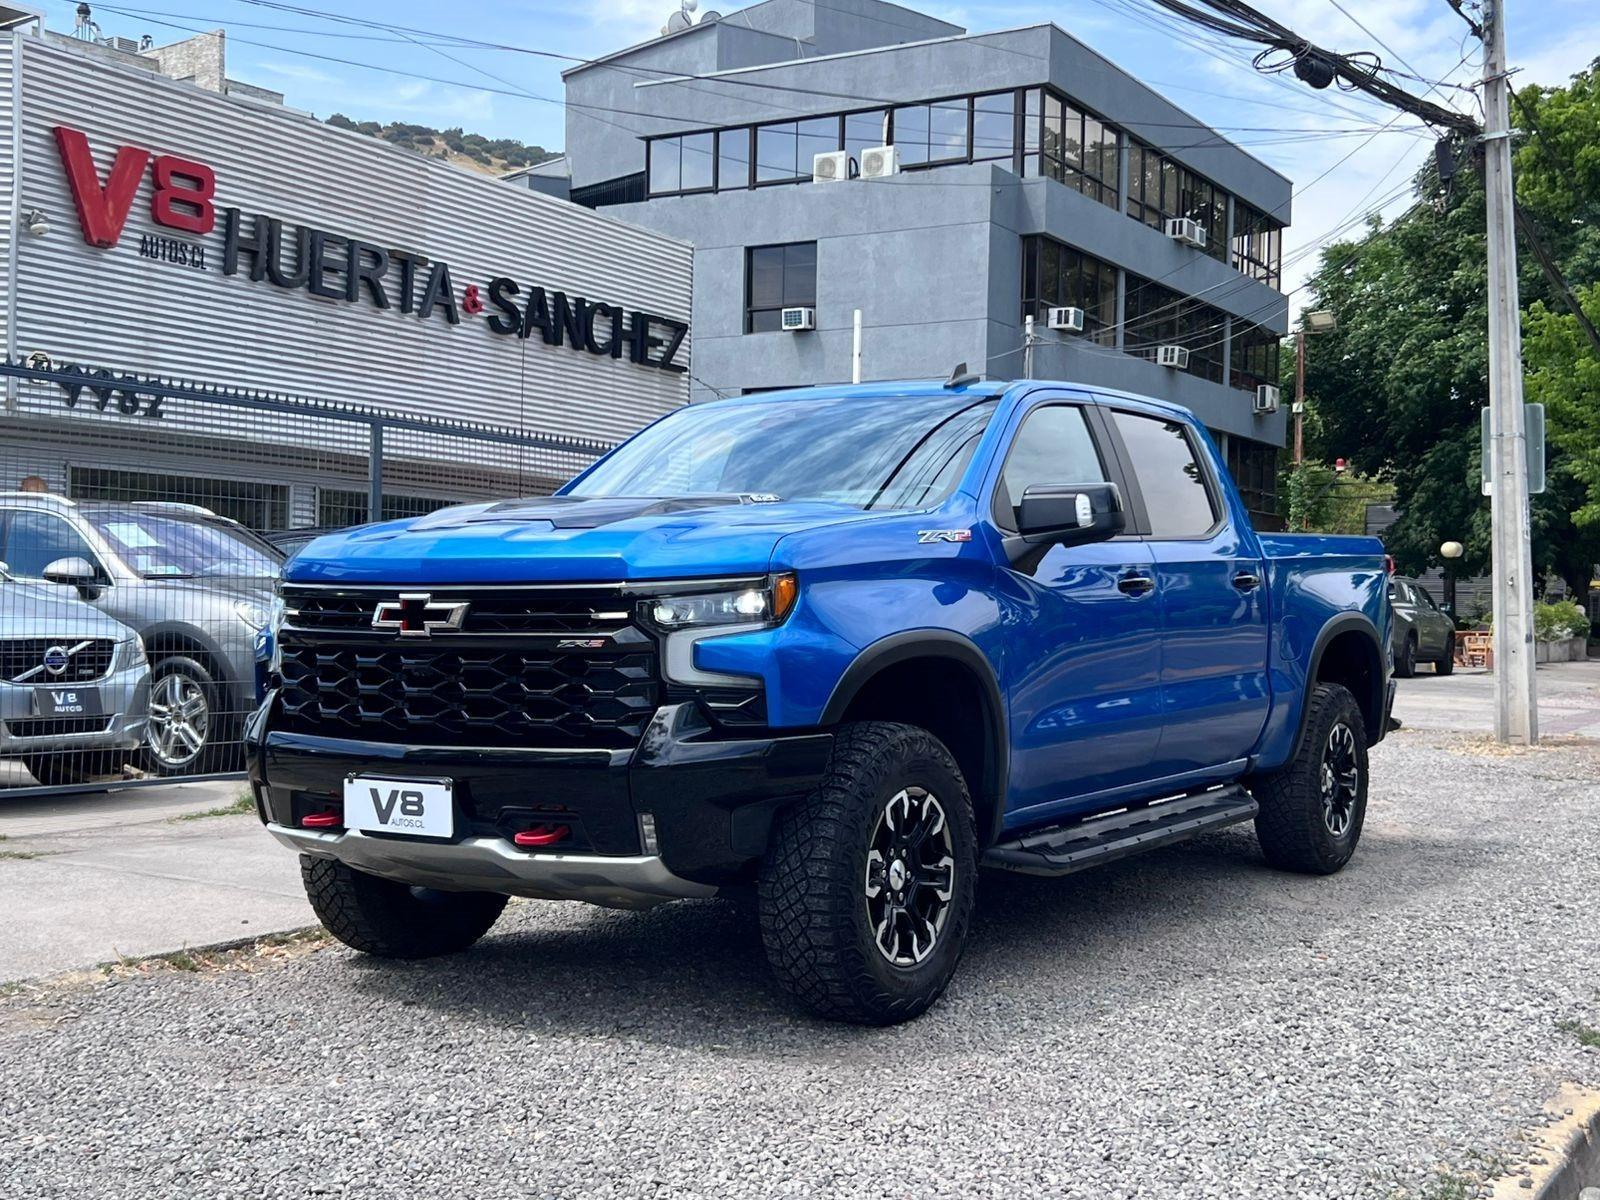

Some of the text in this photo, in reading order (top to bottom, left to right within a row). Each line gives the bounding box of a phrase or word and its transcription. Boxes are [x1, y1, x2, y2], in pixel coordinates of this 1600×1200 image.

[53, 126, 215, 249] V8
[140, 235, 207, 270] AUTOS.CL
[223, 207, 689, 373] HUERTA & SANCHEZ
[917, 529, 972, 544] ZR2
[369, 788, 424, 825] V8
[391, 818, 425, 828] AUTOS.CL
